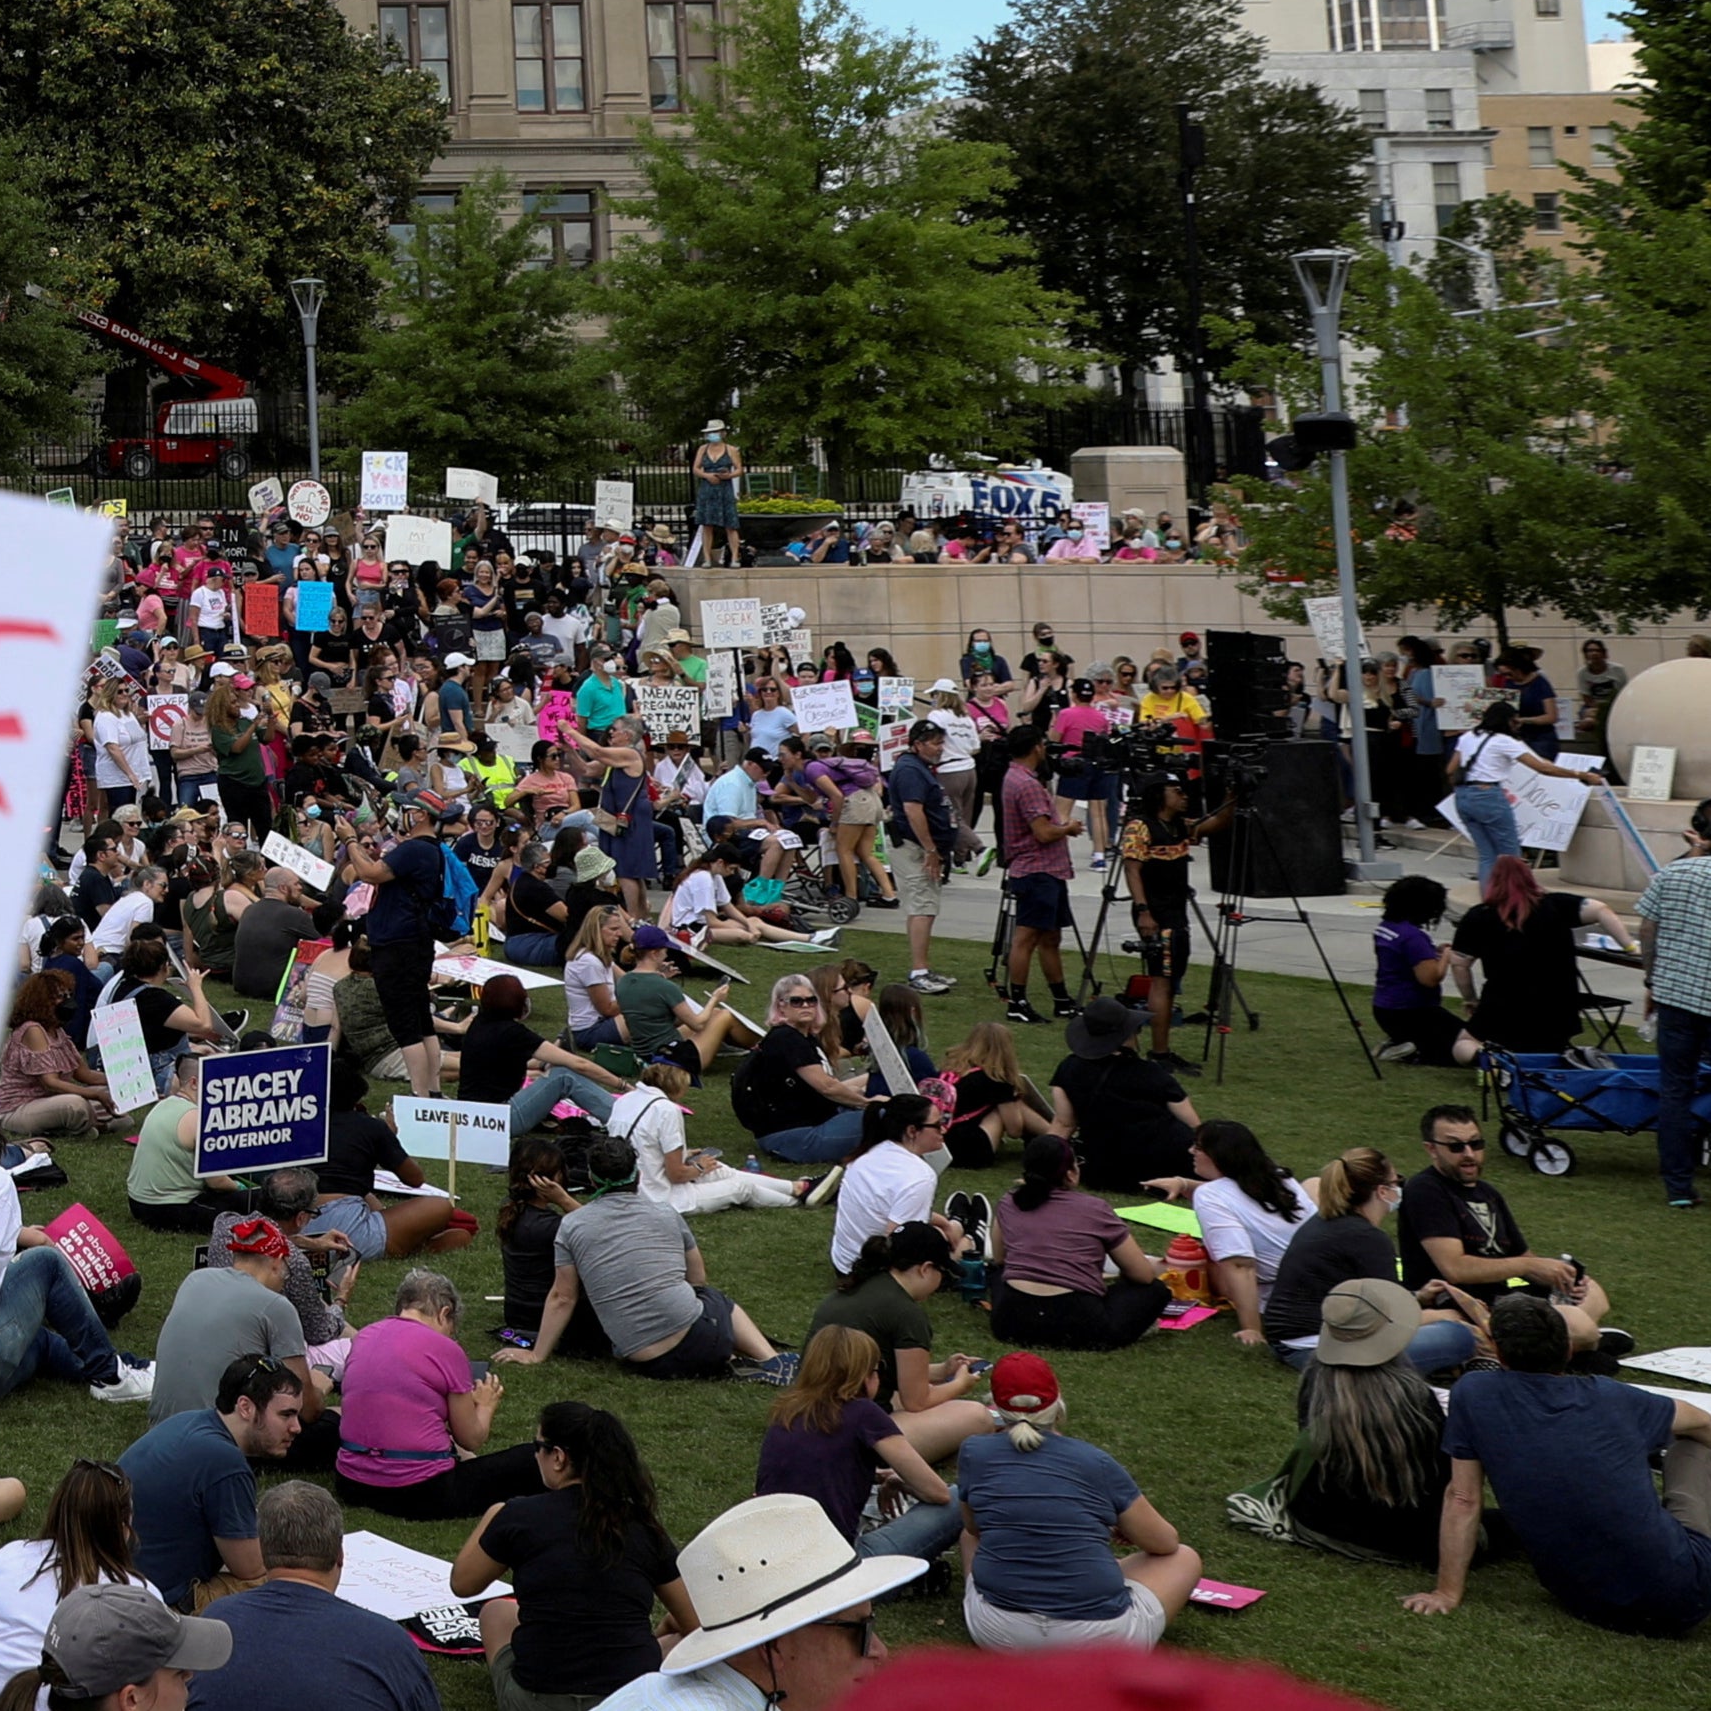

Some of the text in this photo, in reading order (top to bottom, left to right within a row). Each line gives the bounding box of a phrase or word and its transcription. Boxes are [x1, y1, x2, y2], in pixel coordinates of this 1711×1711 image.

[111, 324, 178, 361] BOOM 45-J
[363, 493, 405, 507] SCOTUS
[971, 479, 1061, 518] FOX 5
[295, 504, 313, 513] HELL
[222, 529, 239, 542] IN
[706, 600, 733, 612] YOU
[716, 613, 753, 626] SPEAK
[712, 629, 756, 643] FOR ME
[642, 688, 698, 701] MEN GOT
[205, 1068, 304, 1105] STACEY
[204, 1095, 318, 1133] ABRAMS
[415, 1108, 450, 1124] LEAVE
[456, 1113, 469, 1127] US
[203, 1127, 292, 1153] GOVERNOR
[68, 1228, 84, 1247] un
[76, 1220, 121, 1284] El aborto es
[59, 1236, 100, 1291] de salud.
